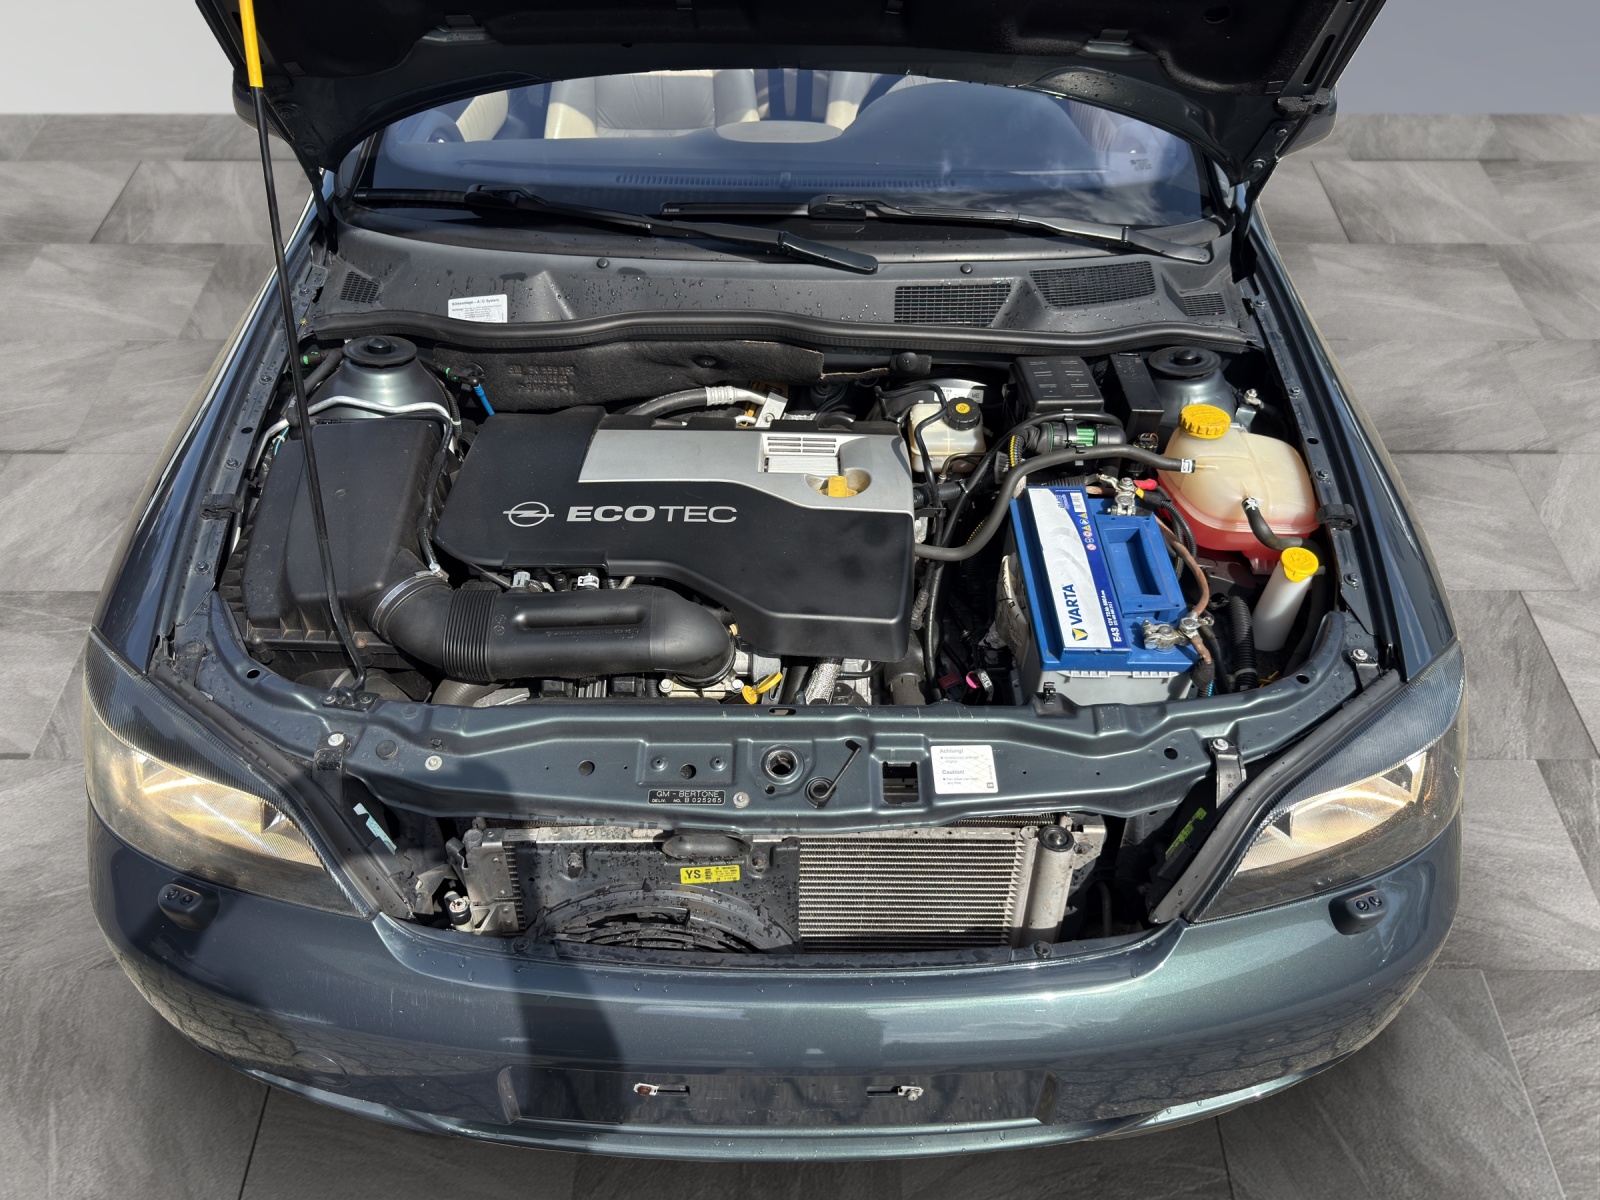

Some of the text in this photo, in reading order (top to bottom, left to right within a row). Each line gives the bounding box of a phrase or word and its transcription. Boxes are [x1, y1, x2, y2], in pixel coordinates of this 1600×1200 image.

[566, 505, 737, 523] ECOTEC
[1062, 584, 1083, 626] VARTA
[1110, 627, 1122, 642] E43
[679, 790, 719, 798] BERTONE
[685, 869, 701, 879] YS
